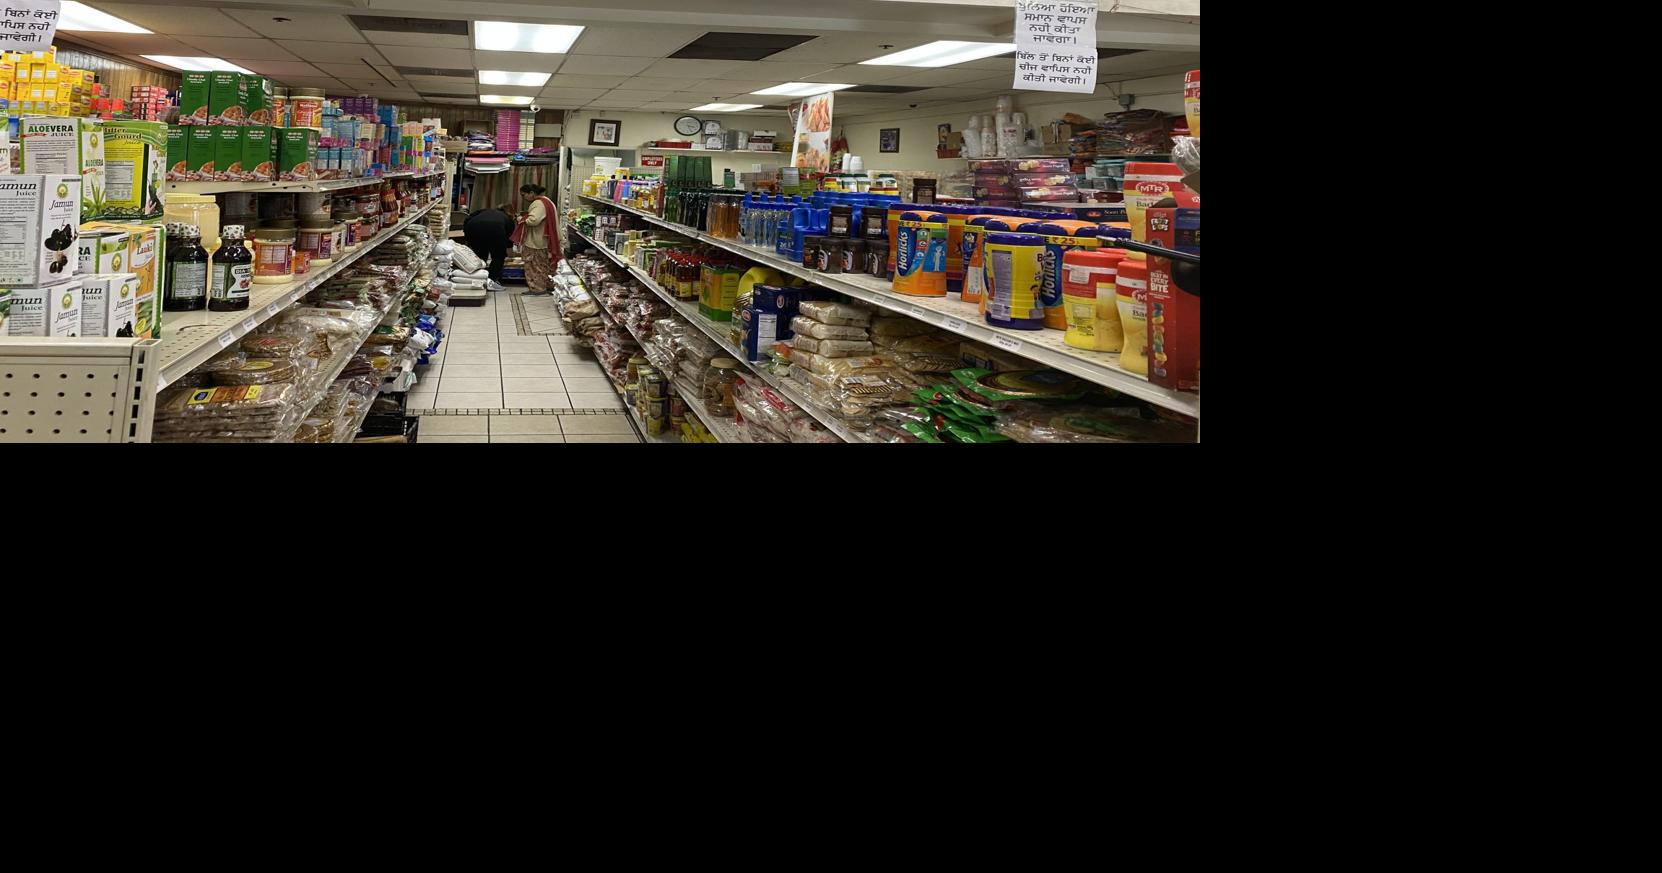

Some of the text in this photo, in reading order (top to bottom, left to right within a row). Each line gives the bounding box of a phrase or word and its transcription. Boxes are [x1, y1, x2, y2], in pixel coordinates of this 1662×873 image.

[5, 8, 58, 20] ਬਿਨਾਂ ਕੋਈ
[1024, 13, 1087, 24] ਸਮਾਨ ਵਾਪਸ
[0, 20, 25, 29] ਾਪਿਸ
[1054, 24, 1080, 34] ਕੀਤਾ
[1077, 55, 1095, 64] ਕੋਈ
[49, 200, 74, 210] Jamun
[898, 231, 908, 270] Horlicks
[1042, 250, 1056, 298] Horlicks
[1151, 283, 1168, 293] BITE
